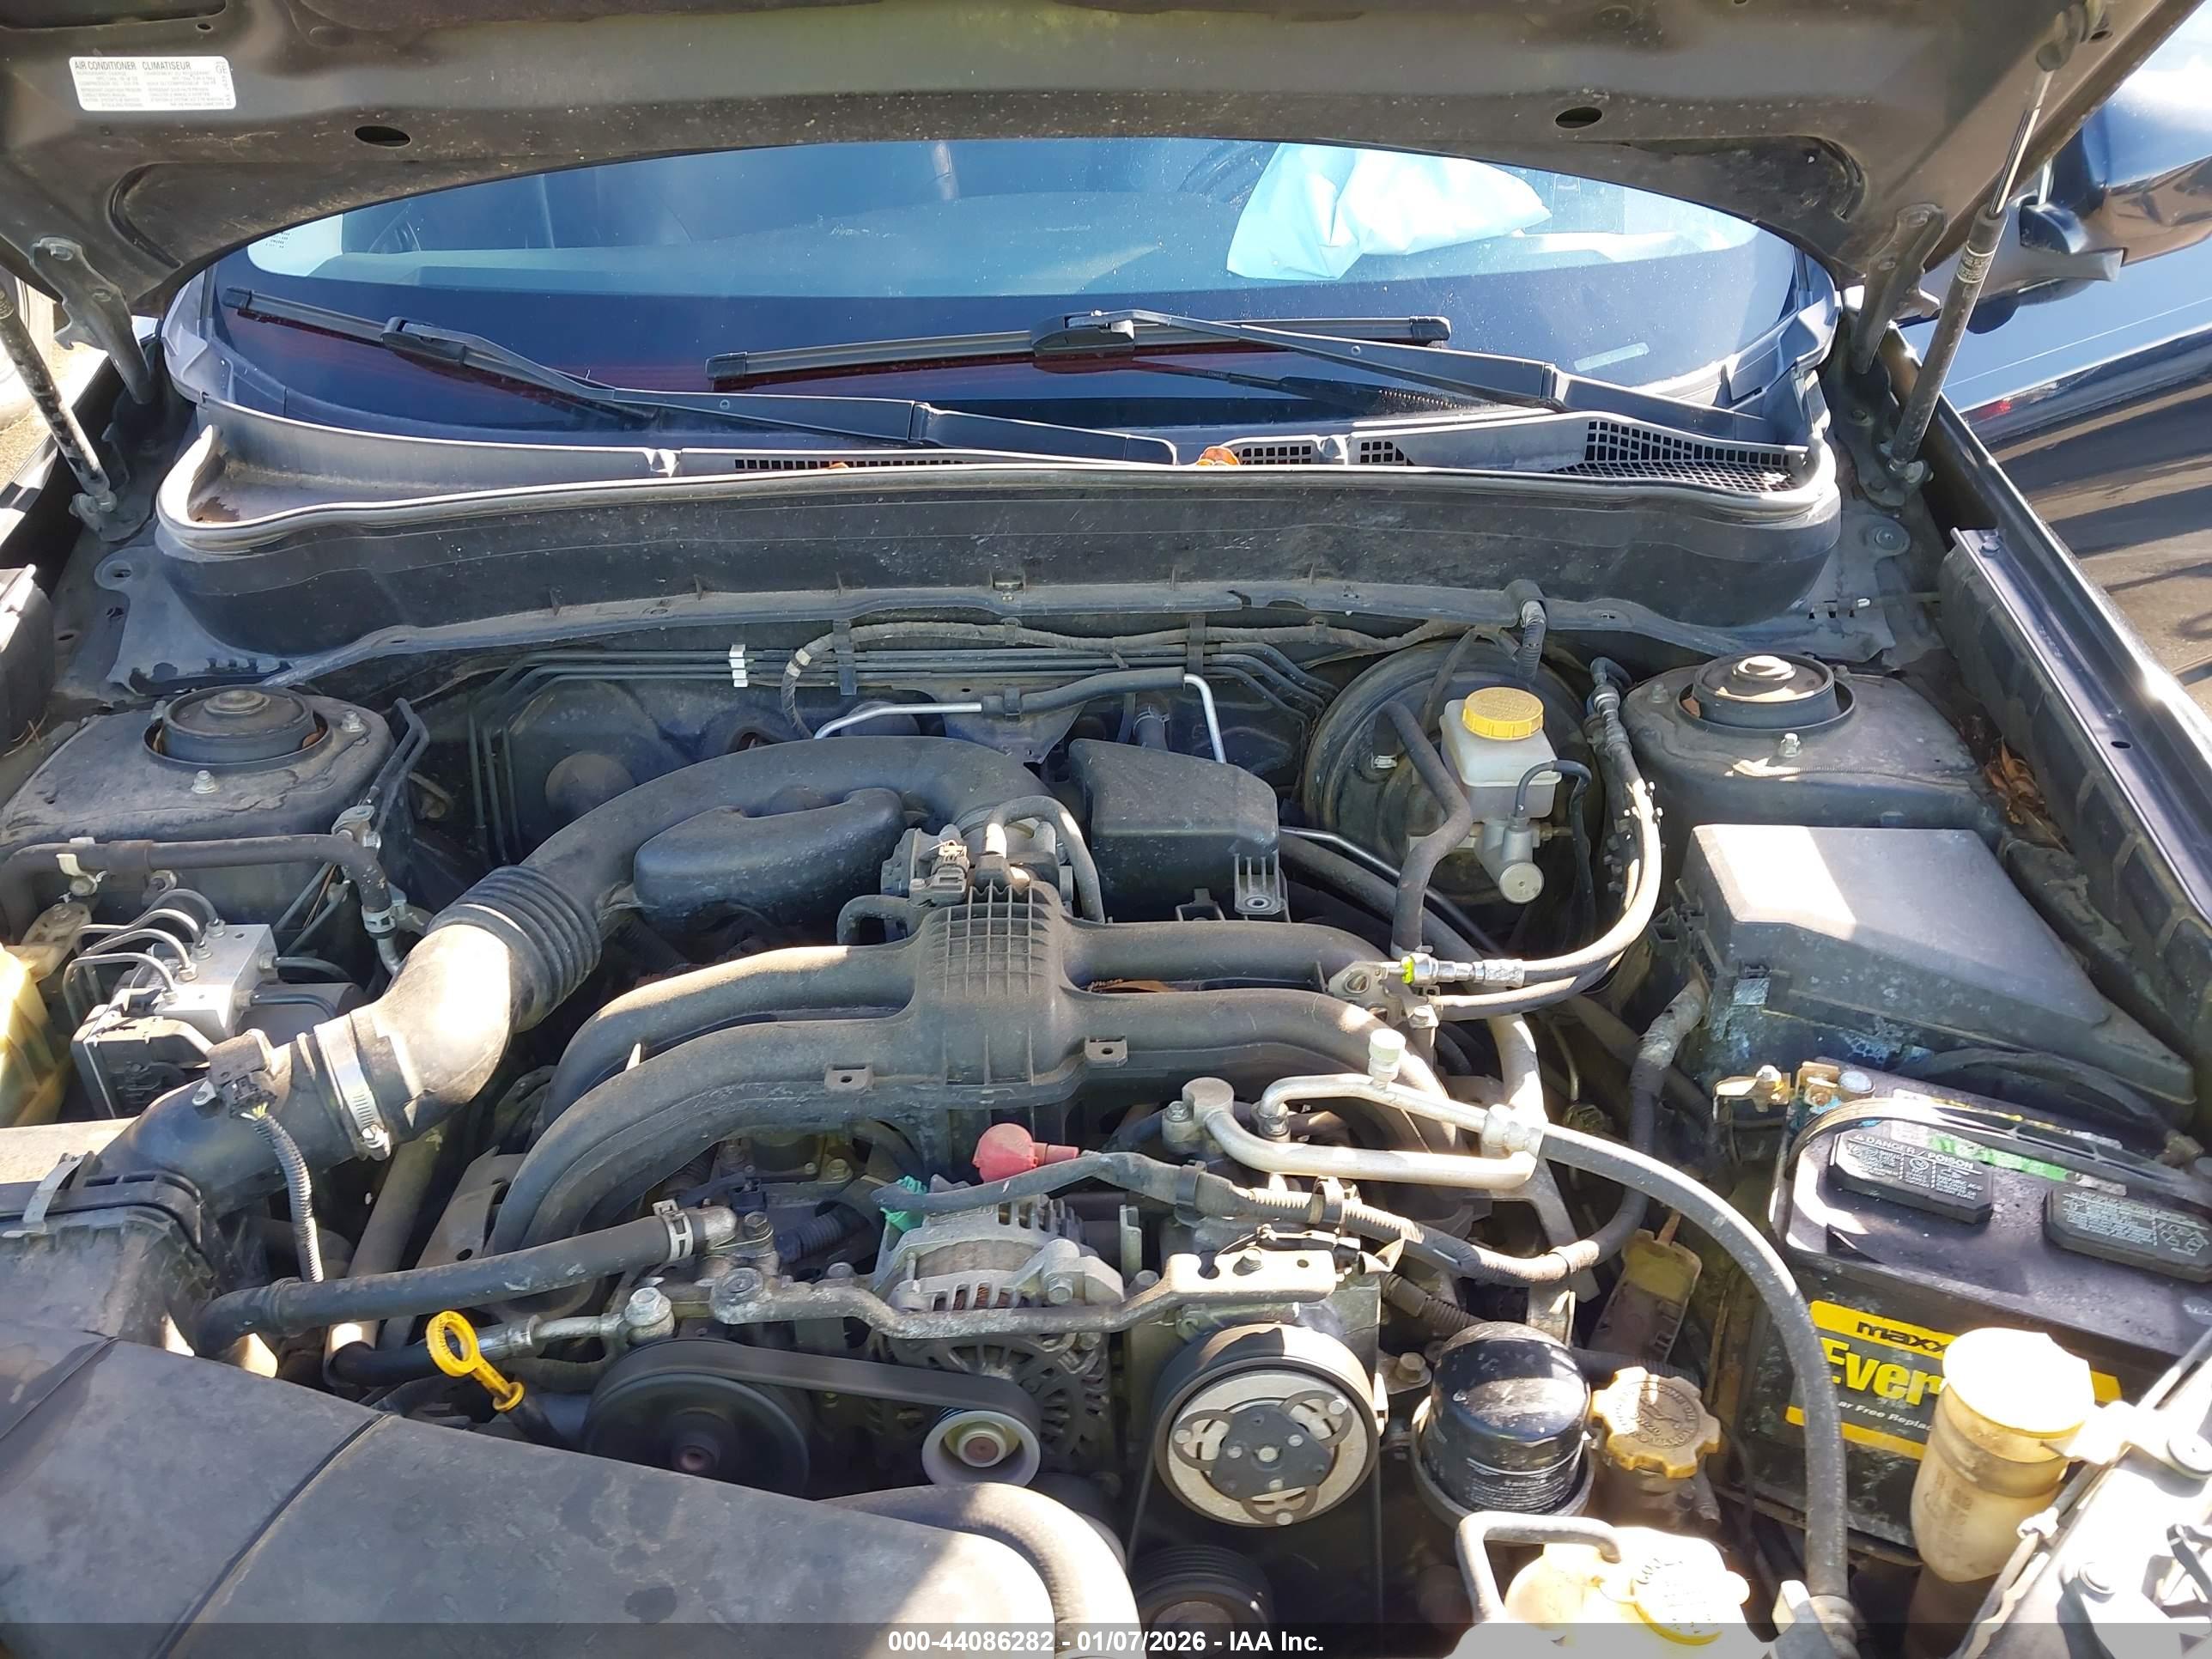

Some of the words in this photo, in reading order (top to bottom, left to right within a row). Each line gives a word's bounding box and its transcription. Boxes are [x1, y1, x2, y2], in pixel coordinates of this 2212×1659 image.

[88, 61, 137, 70] CONDITIONER
[143, 61, 191, 70] CLIMATISEUR
[1866, 1137, 1916, 1154] DANGER
[1928, 1152, 1974, 1170] POISON
[1855, 1405, 1887, 1419] Free
